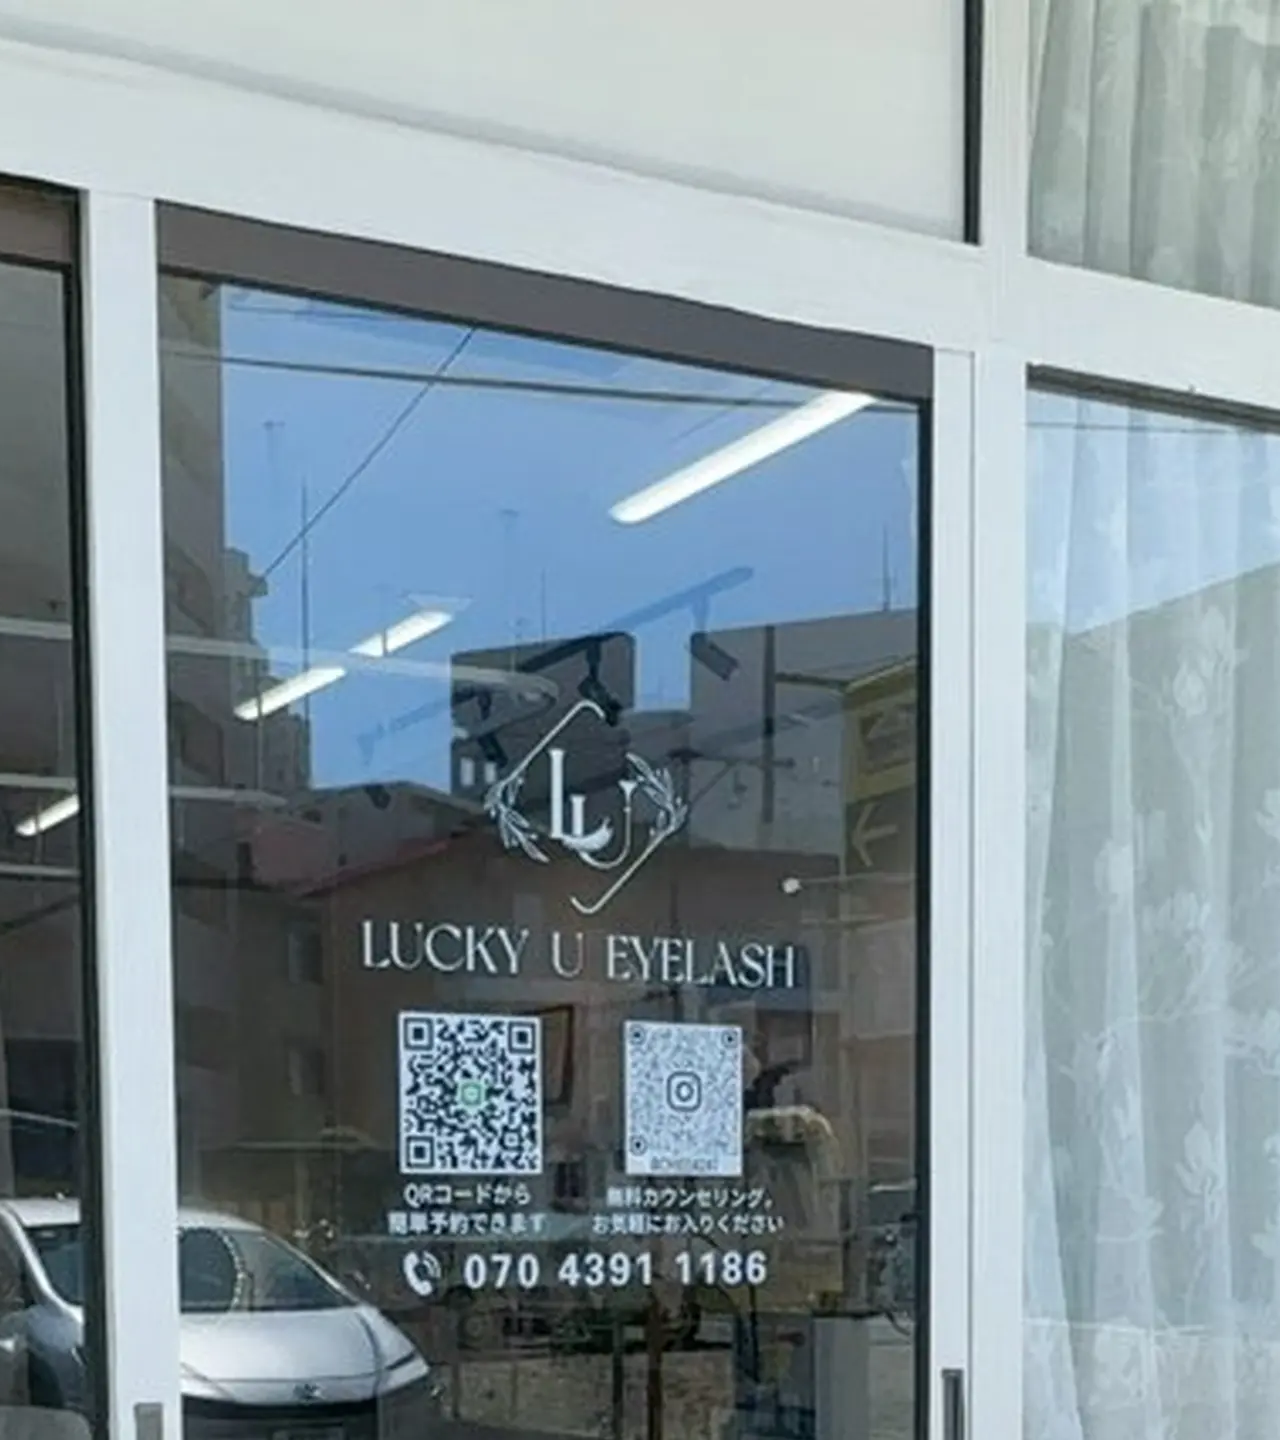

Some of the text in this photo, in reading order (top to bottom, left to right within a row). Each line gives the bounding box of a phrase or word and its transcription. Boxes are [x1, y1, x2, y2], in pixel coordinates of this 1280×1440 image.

[362, 920, 796, 988] LUCKY U EYELASH
[403, 1182, 532, 1208] QRコードから
[591, 1212, 785, 1236] お気軽にお入りください
[464, 1249, 767, 1289] 070 4391 1186
